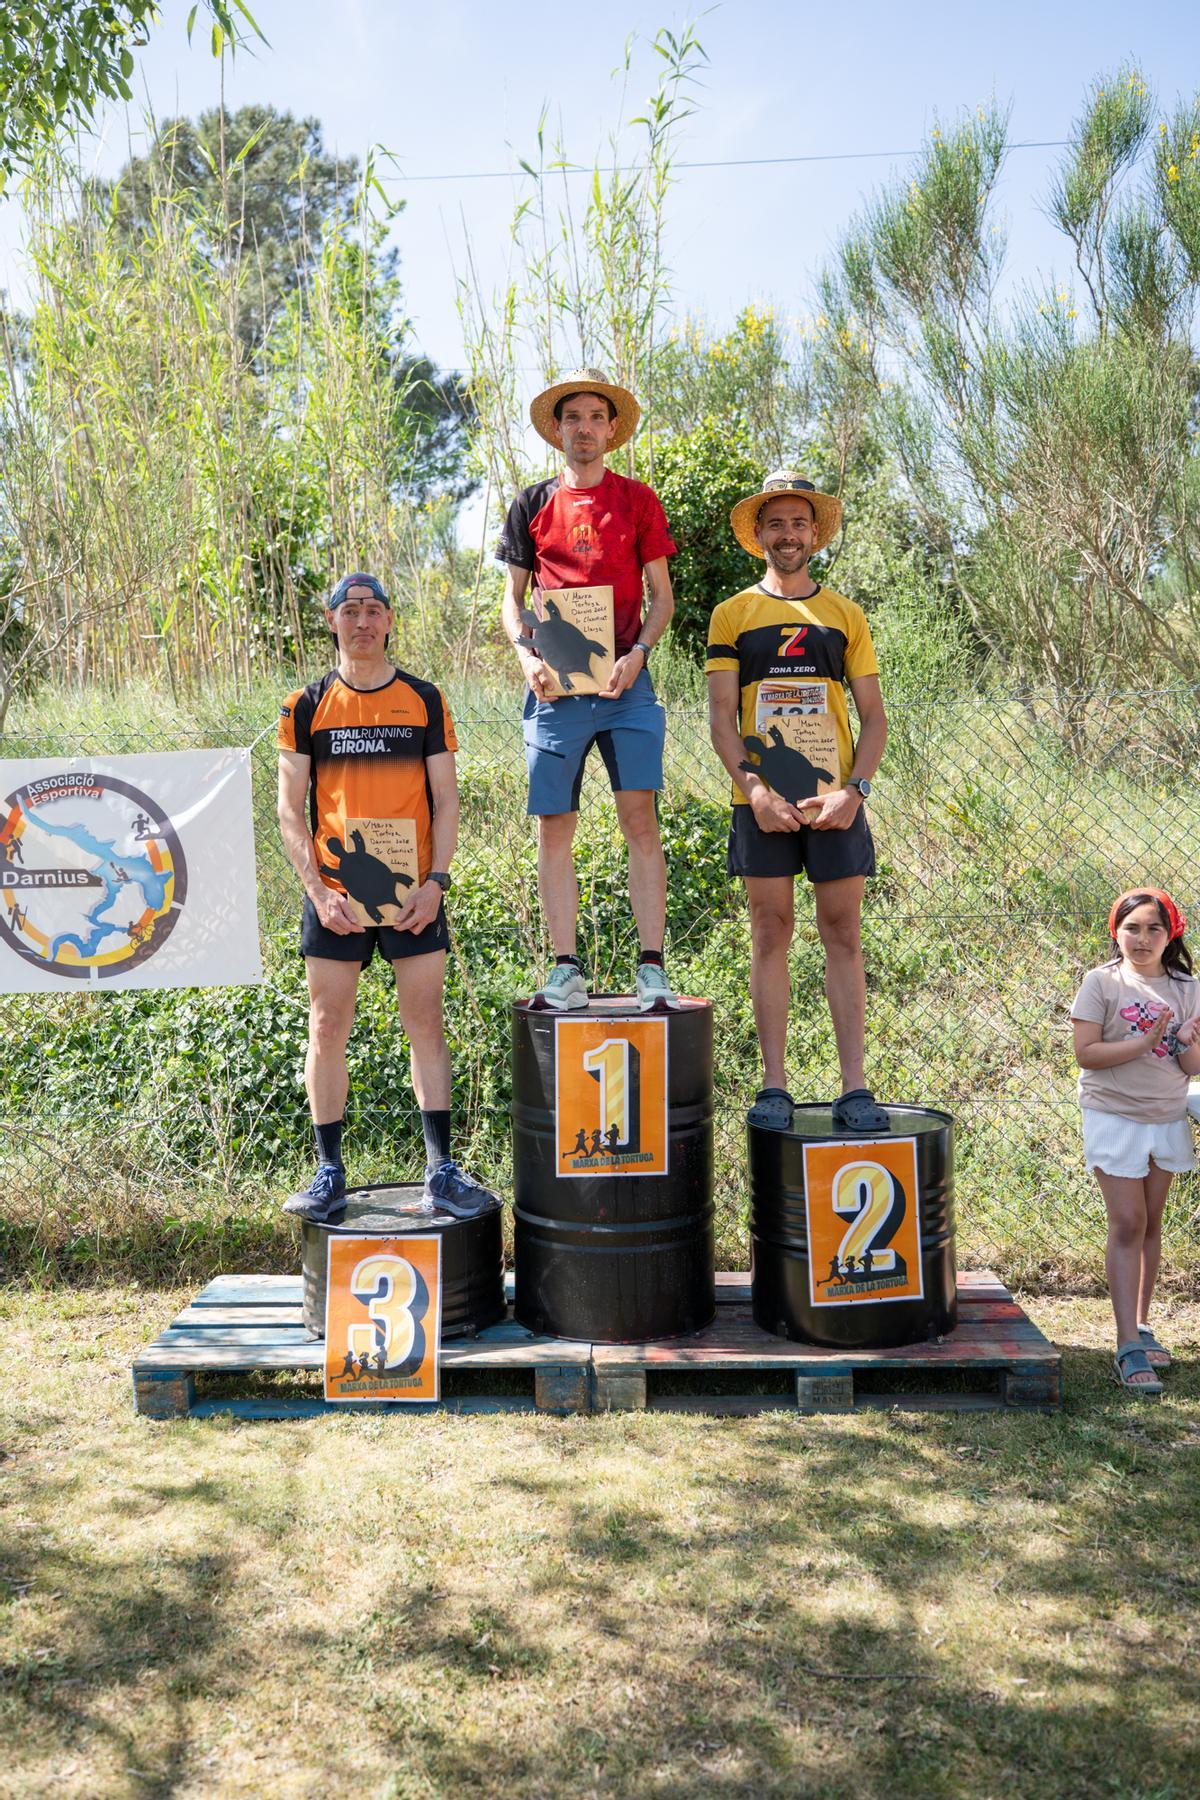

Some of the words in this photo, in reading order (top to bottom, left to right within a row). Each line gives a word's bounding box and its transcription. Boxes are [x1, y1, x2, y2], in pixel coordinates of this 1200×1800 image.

[563, 592, 570, 601] V
[782, 718, 790, 728] V
[26, 774, 94, 797] Associació
[31, 786, 100, 806] Esportiva
[2, 870, 89, 886] Darnius
[583, 1038, 637, 1150] 1
[572, 1157, 599, 1168] MARXA
[600, 1156, 611, 1166] DE
[611, 1154, 620, 1165] LA
[622, 1152, 654, 1164] TORTUGA
[832, 1160, 902, 1275] 2
[826, 1284, 855, 1296] MARXA
[856, 1283, 865, 1293] DE
[866, 1282, 875, 1291] LA
[876, 1276, 908, 1289] TORTUGA
[348, 1254, 424, 1374] 3
[390, 1378, 422, 1388] TORTUGA
